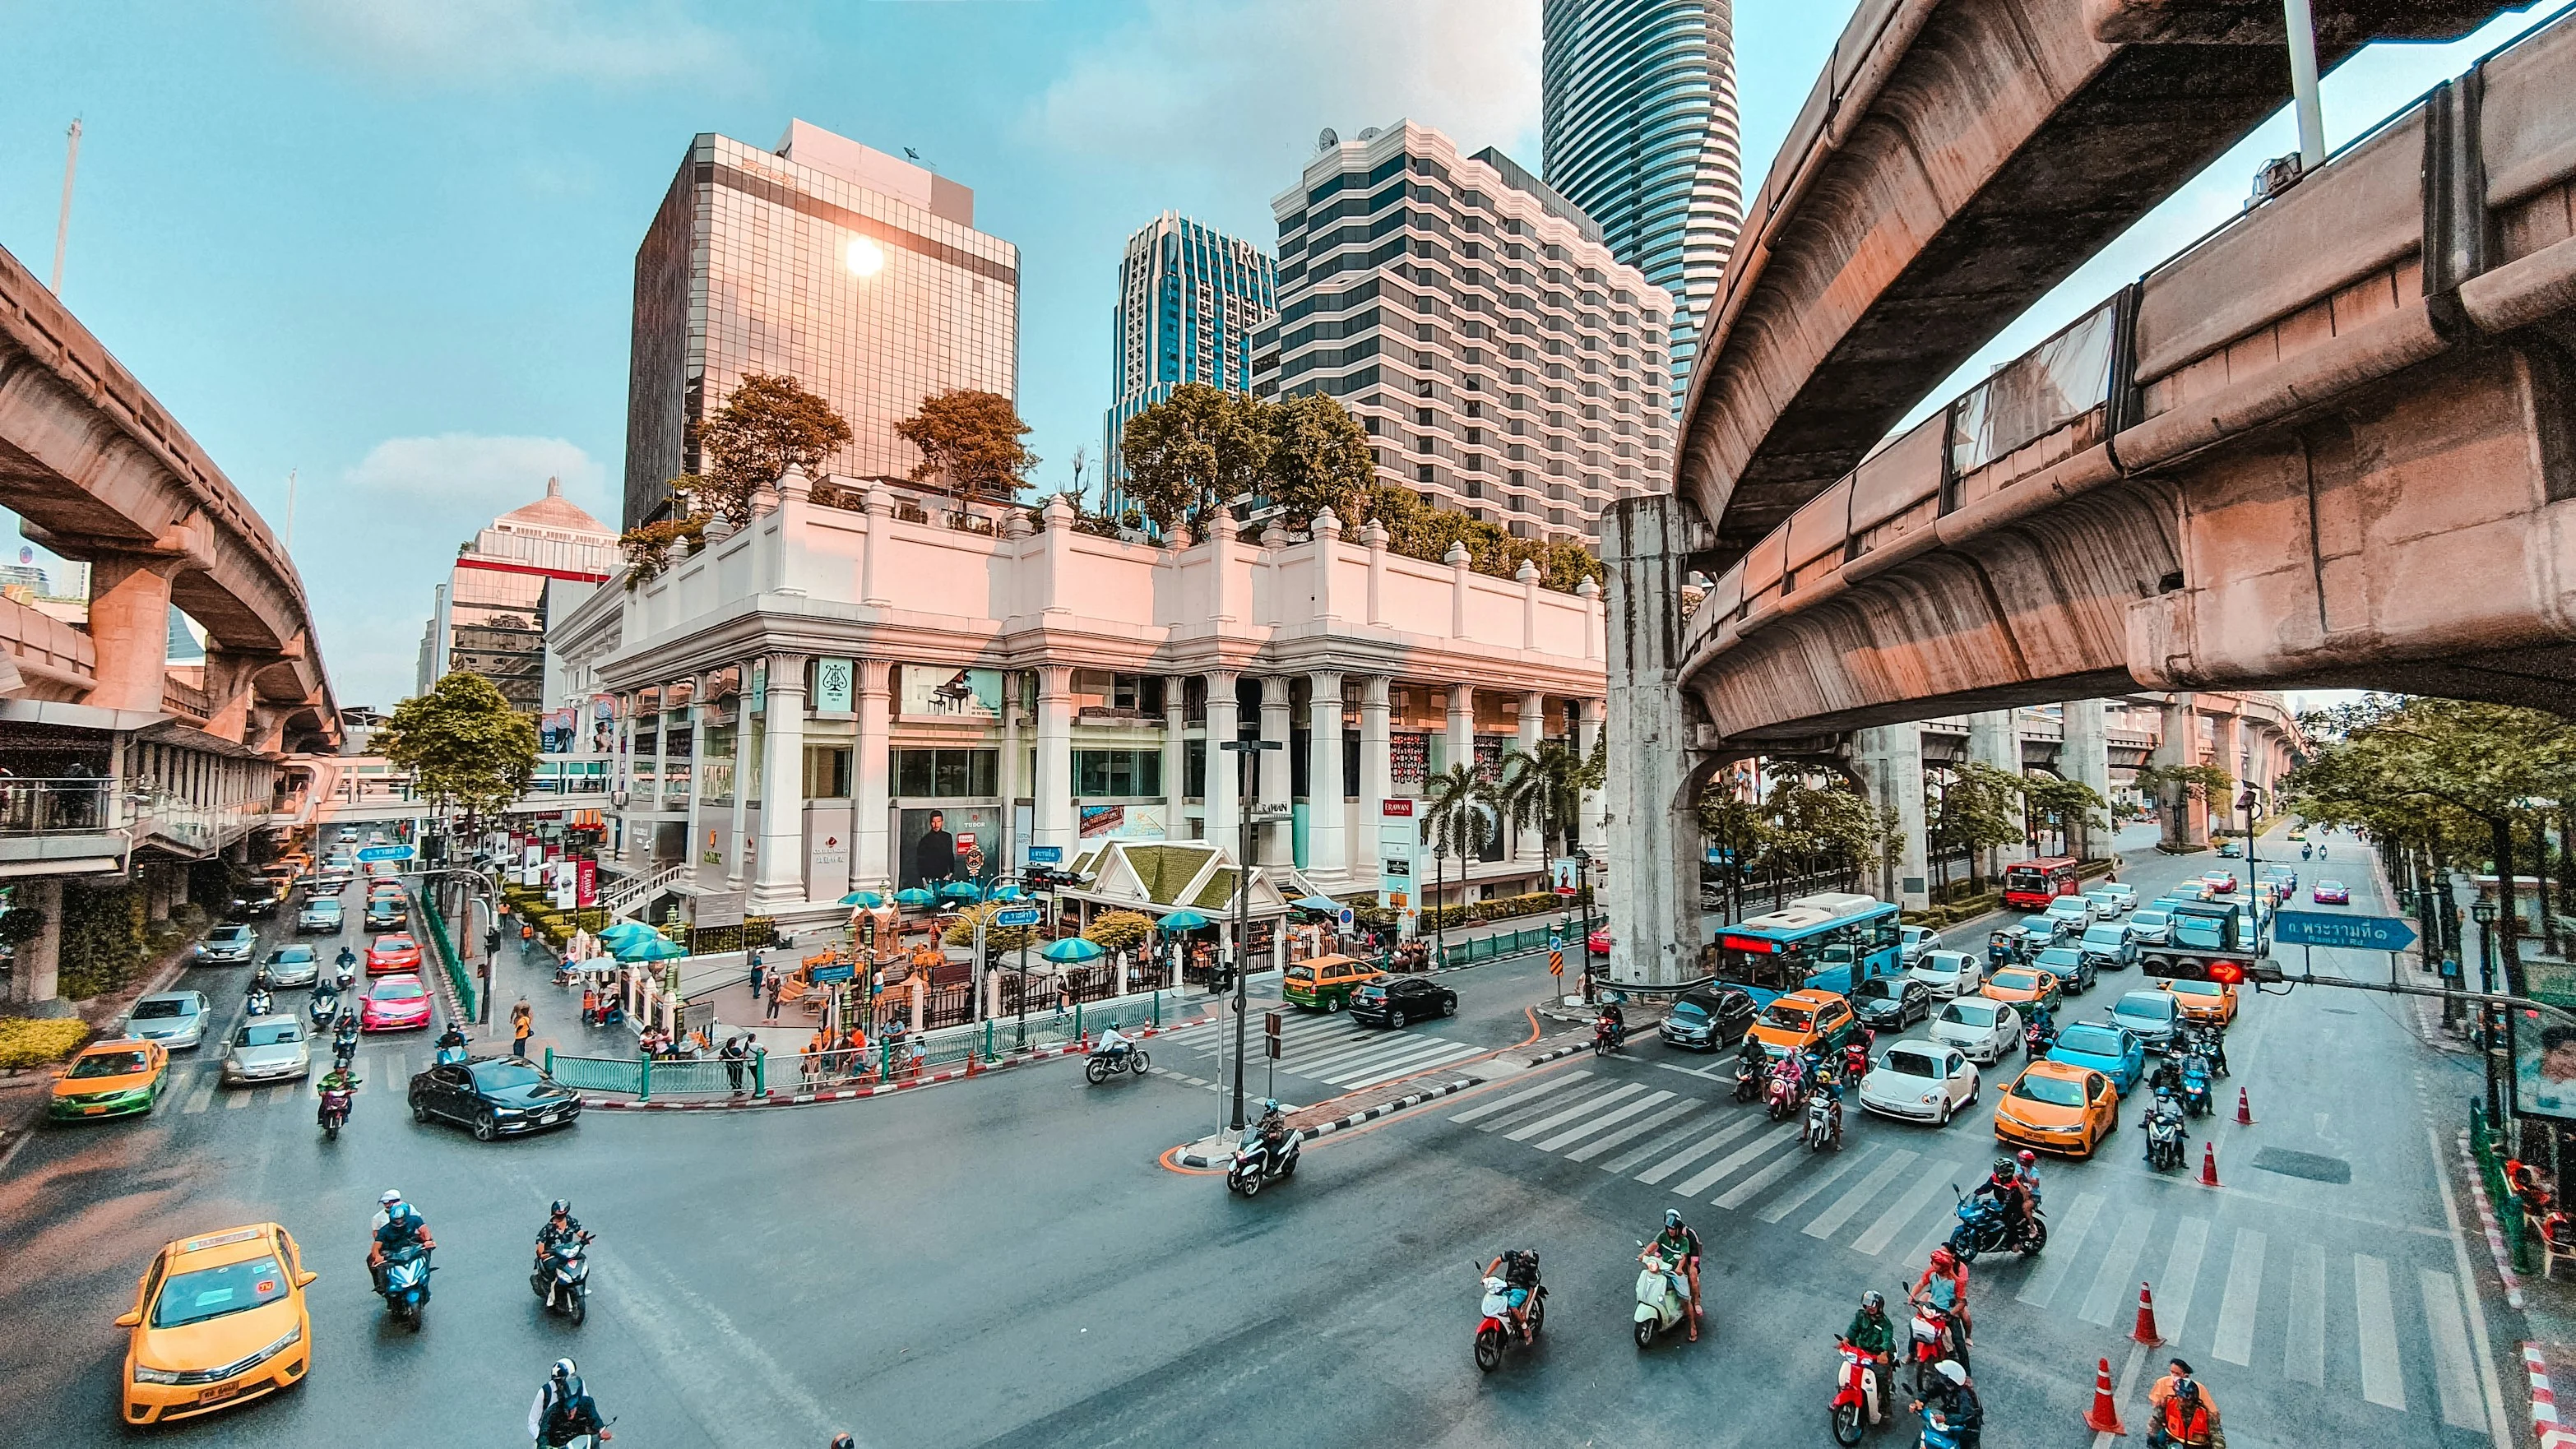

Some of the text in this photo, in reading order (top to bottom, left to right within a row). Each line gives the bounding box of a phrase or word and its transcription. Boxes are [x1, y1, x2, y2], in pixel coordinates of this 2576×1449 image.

[1384, 803, 1409, 812] ERAWAN
[584, 869, 593, 897] ERAWAN
[2308, 935, 2337, 944] Rama
[2350, 937, 2363, 946] Rd
